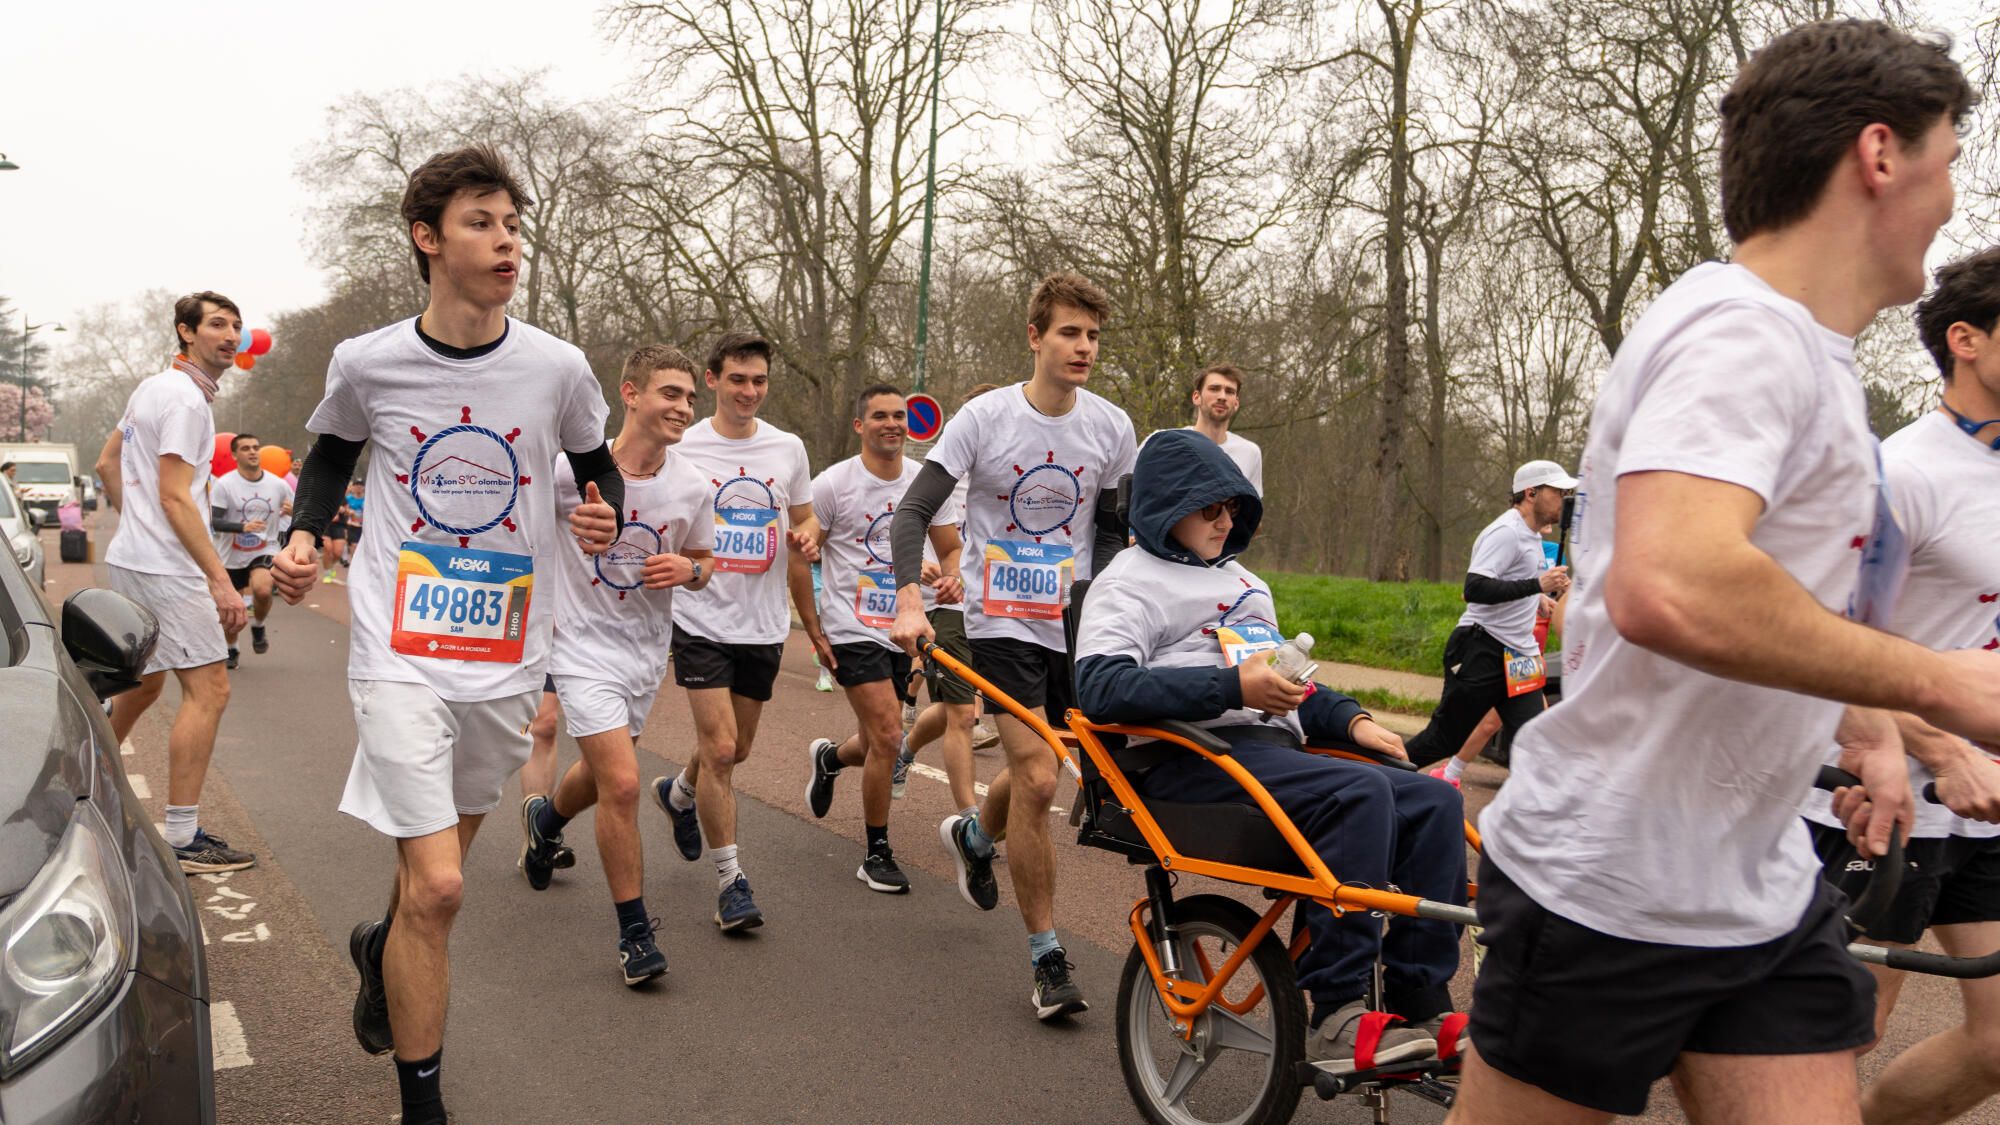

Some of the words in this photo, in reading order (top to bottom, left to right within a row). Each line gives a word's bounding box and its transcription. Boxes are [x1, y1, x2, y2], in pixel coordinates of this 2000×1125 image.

[732, 512, 756, 521] HOKA
[1016, 546, 1044, 557] HOKA
[448, 556, 491, 573] HOKA
[992, 566, 1057, 595] 48808
[409, 583, 504, 626] 49883
[867, 592, 897, 613] 537
[450, 625, 464, 633] SAM
[510, 611, 520, 637] 2H00
